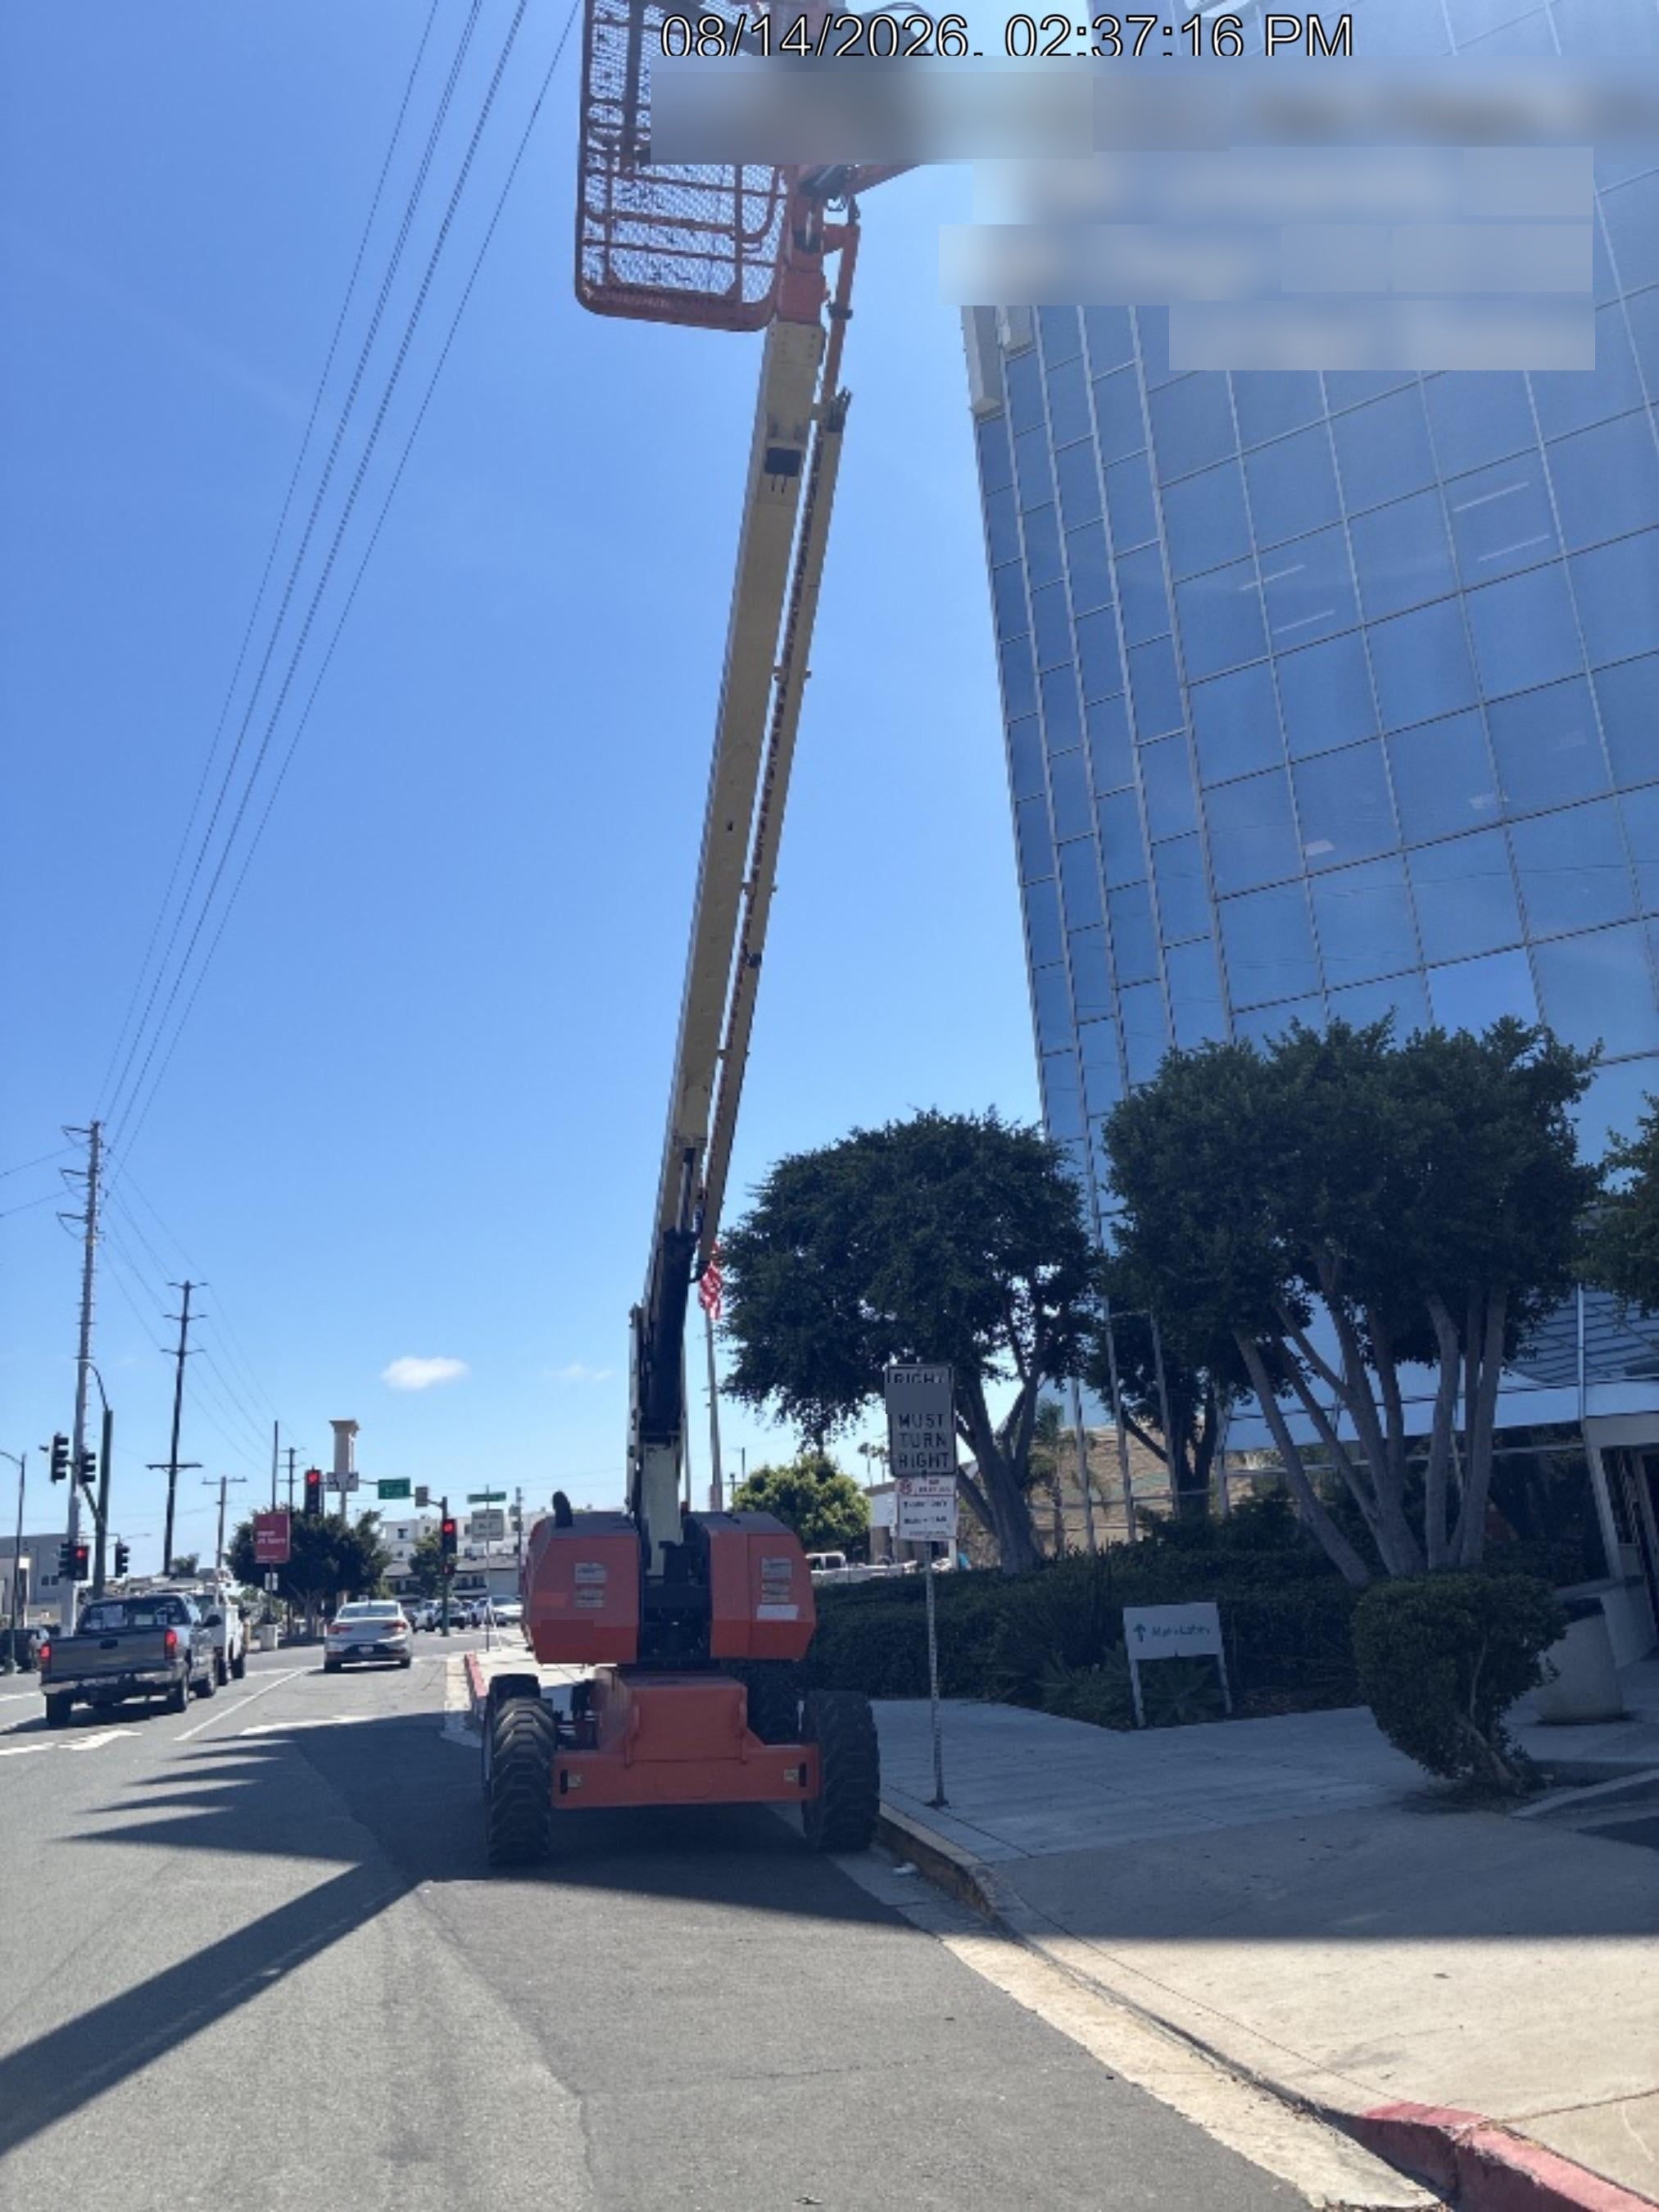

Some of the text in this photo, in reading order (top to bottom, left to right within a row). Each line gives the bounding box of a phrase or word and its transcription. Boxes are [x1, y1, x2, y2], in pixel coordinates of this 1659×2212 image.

[899, 1413, 944, 1429] MUST
[900, 1433, 946, 1448] TURN
[899, 1452, 950, 1469] RIGHT
